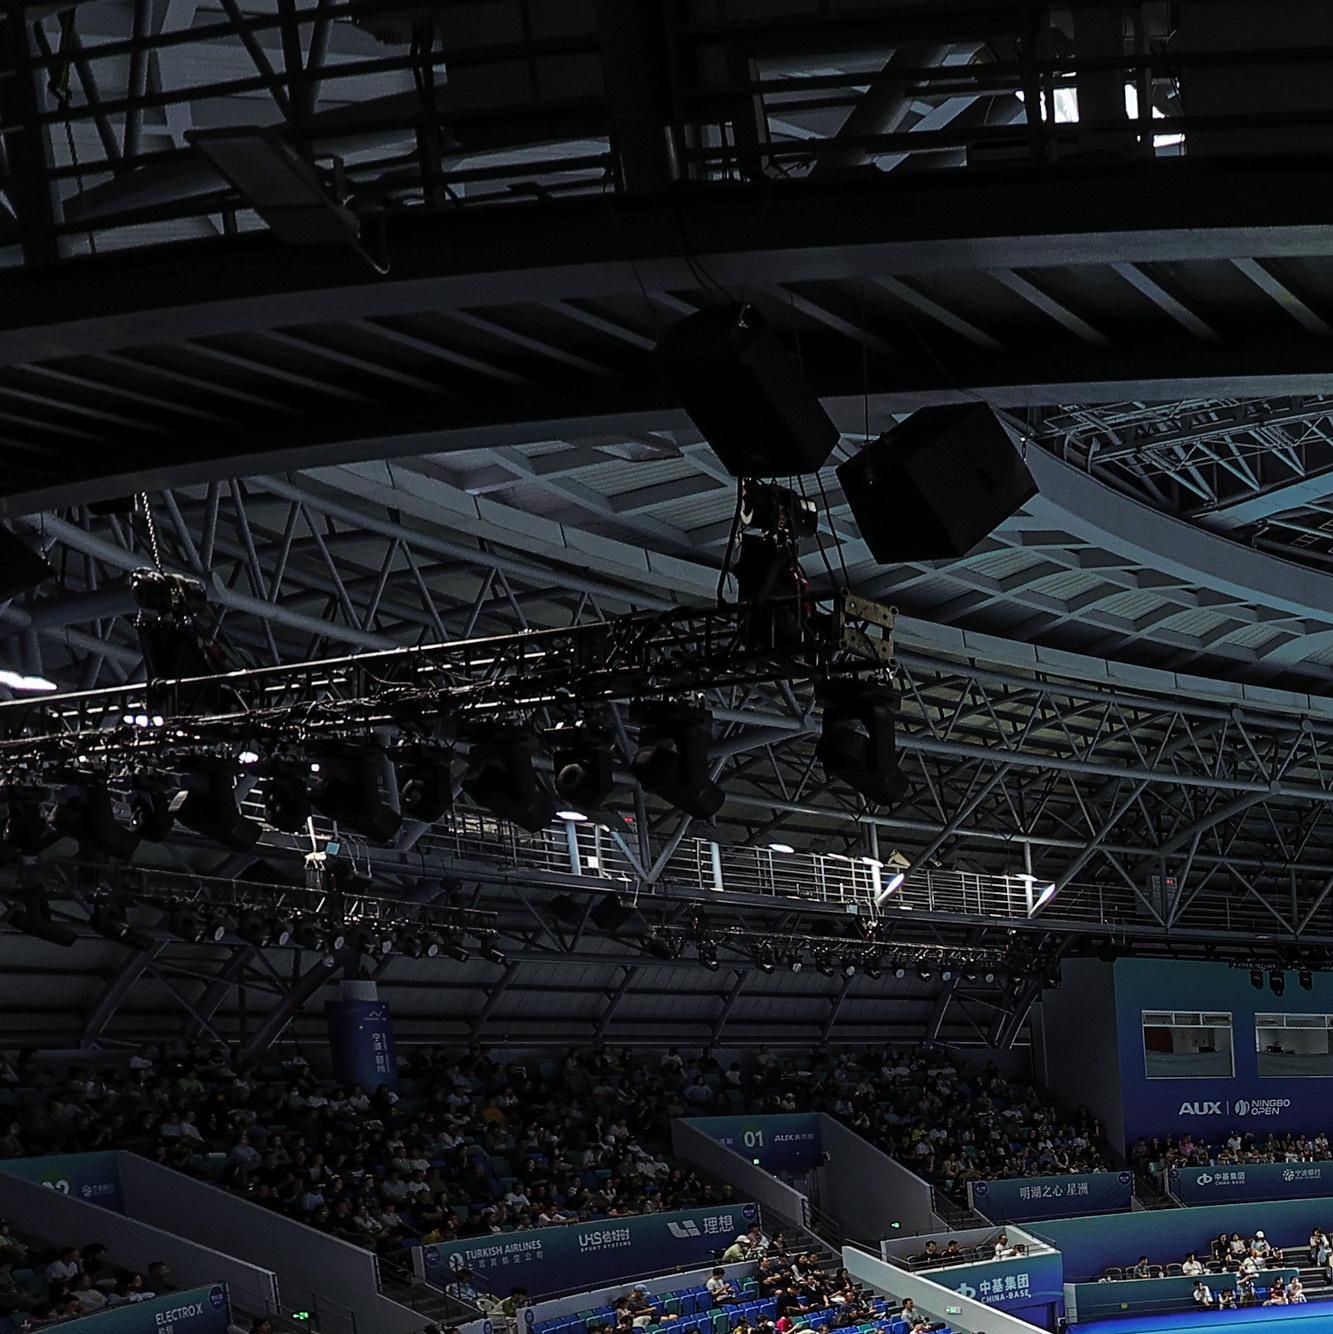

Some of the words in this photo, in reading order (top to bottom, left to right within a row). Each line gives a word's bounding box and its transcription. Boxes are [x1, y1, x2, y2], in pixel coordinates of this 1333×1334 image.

[1178, 1100, 1223, 1116] AUX
[1250, 1105, 1281, 1116] OPEN
[1251, 1098, 1291, 1108] NINGBO
[743, 1130, 764, 1148] 01
[703, 1214, 734, 1235] 理想
[465, 1246, 503, 1260] TURKISH
[504, 1239, 542, 1254] AIRLINES
[979, 1273, 1030, 1296] 中基集团
[981, 1289, 1030, 1304] CHINA-BASE
[155, 1306, 195, 1325] ELECTRO
[195, 1302, 204, 1315] X
